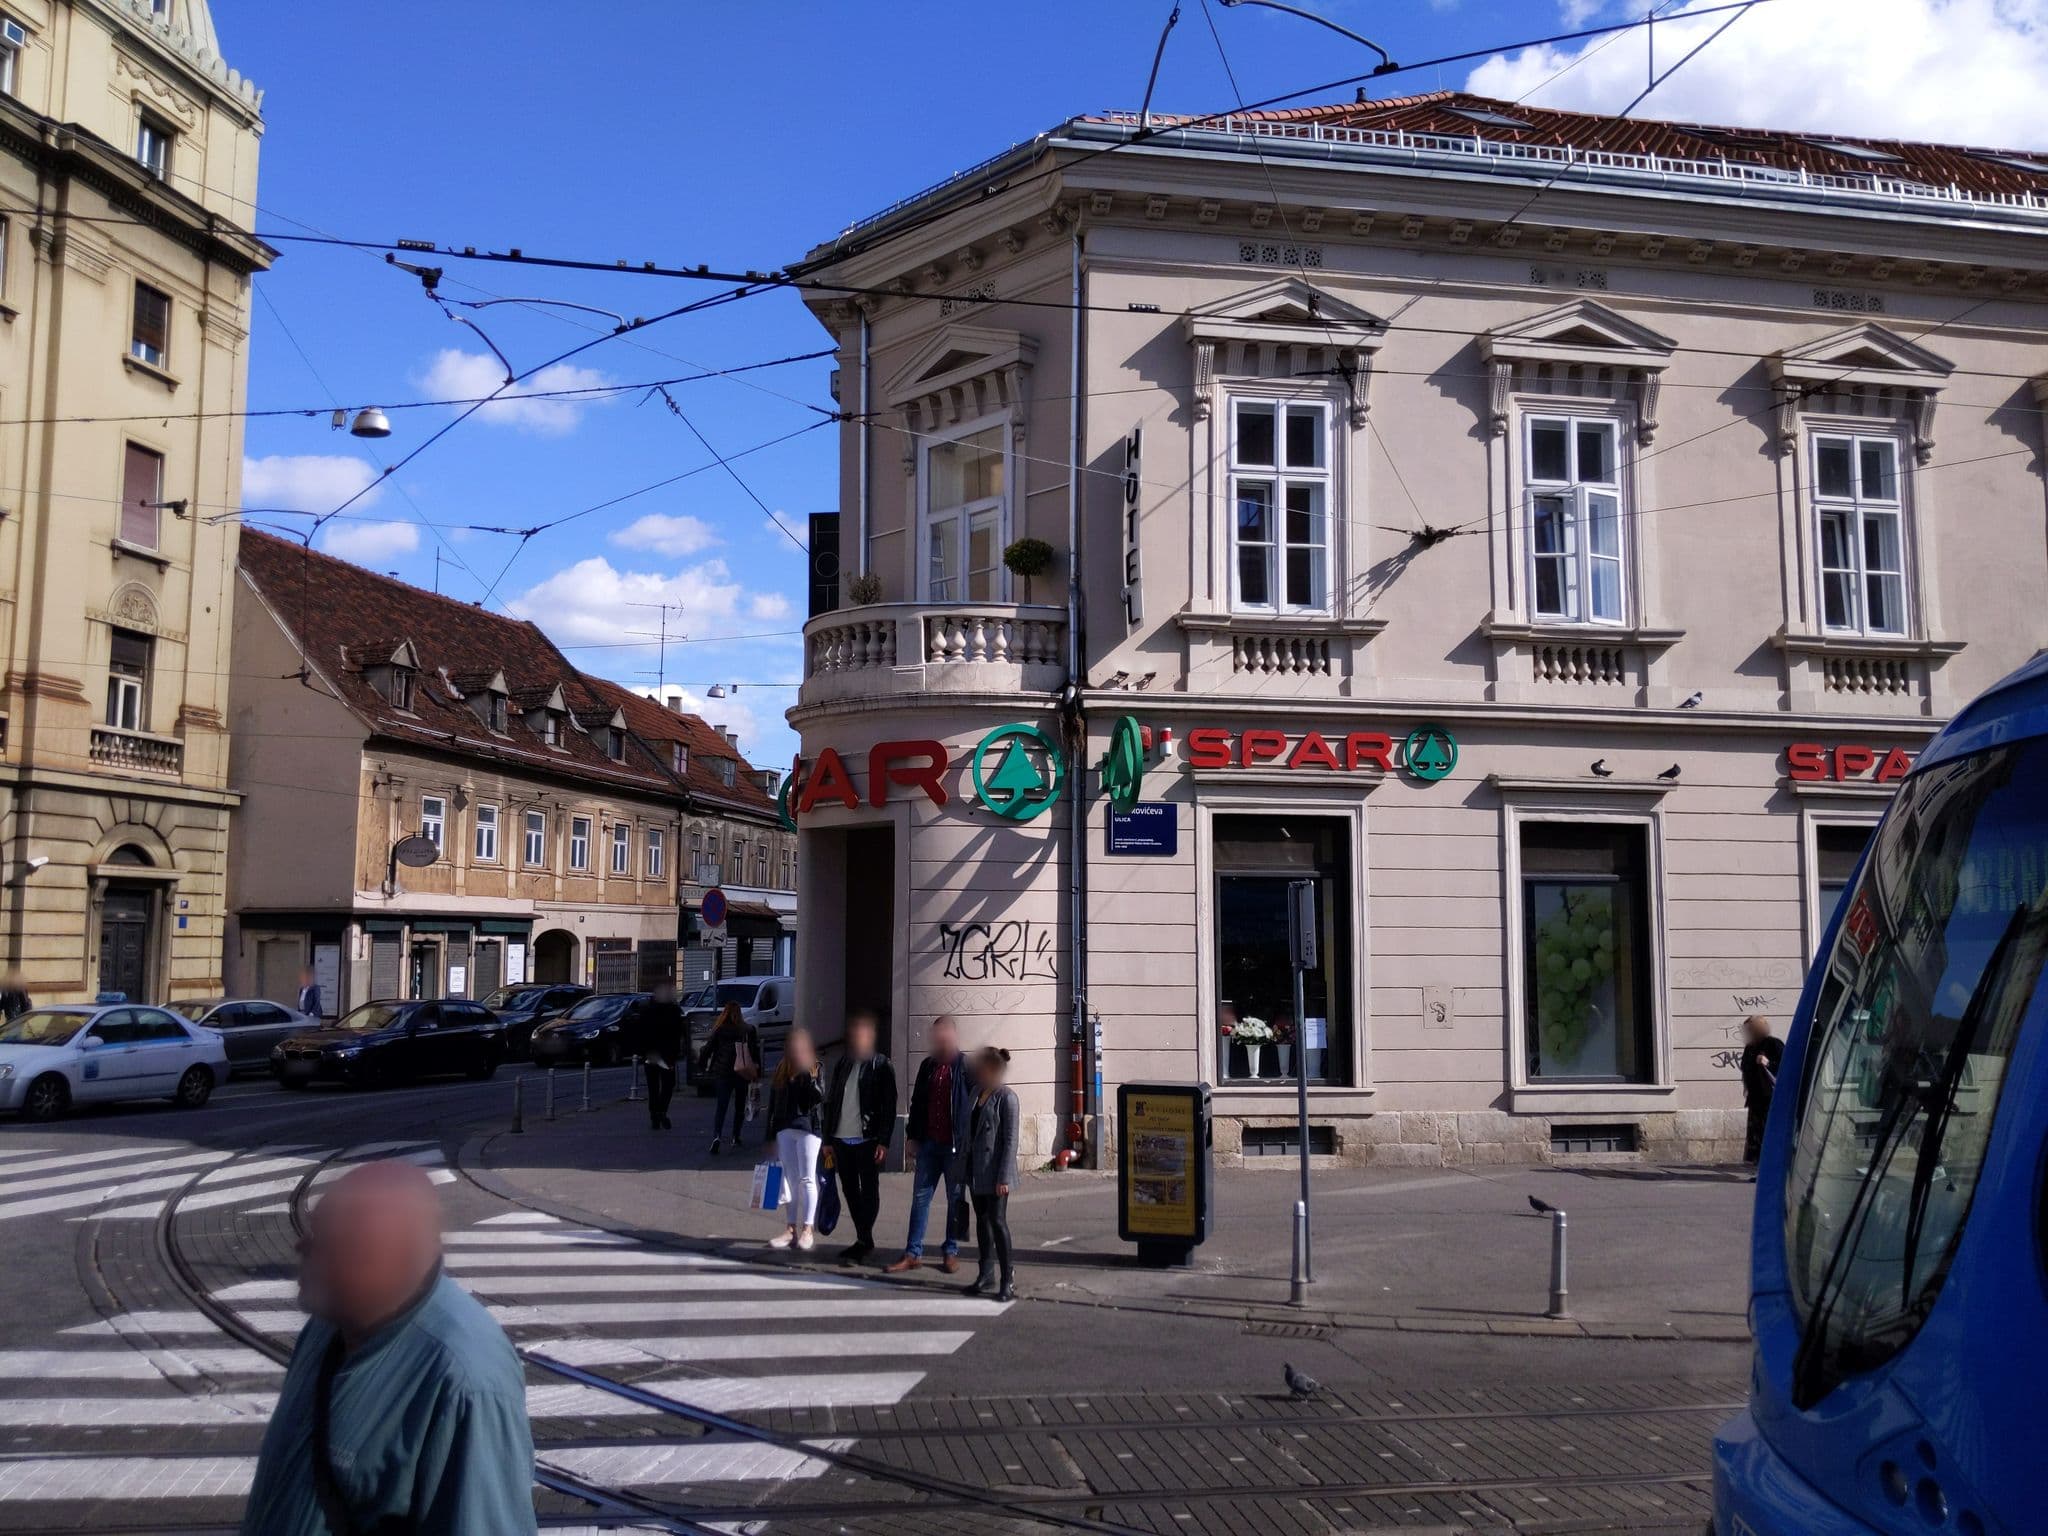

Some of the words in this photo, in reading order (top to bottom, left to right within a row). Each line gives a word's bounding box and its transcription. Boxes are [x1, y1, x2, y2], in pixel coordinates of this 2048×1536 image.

[1126, 428, 1141, 626] HOTEL
[791, 740, 949, 814] AR
[1188, 728, 1393, 772] SPAR
[1788, 743, 1911, 783] SPA
